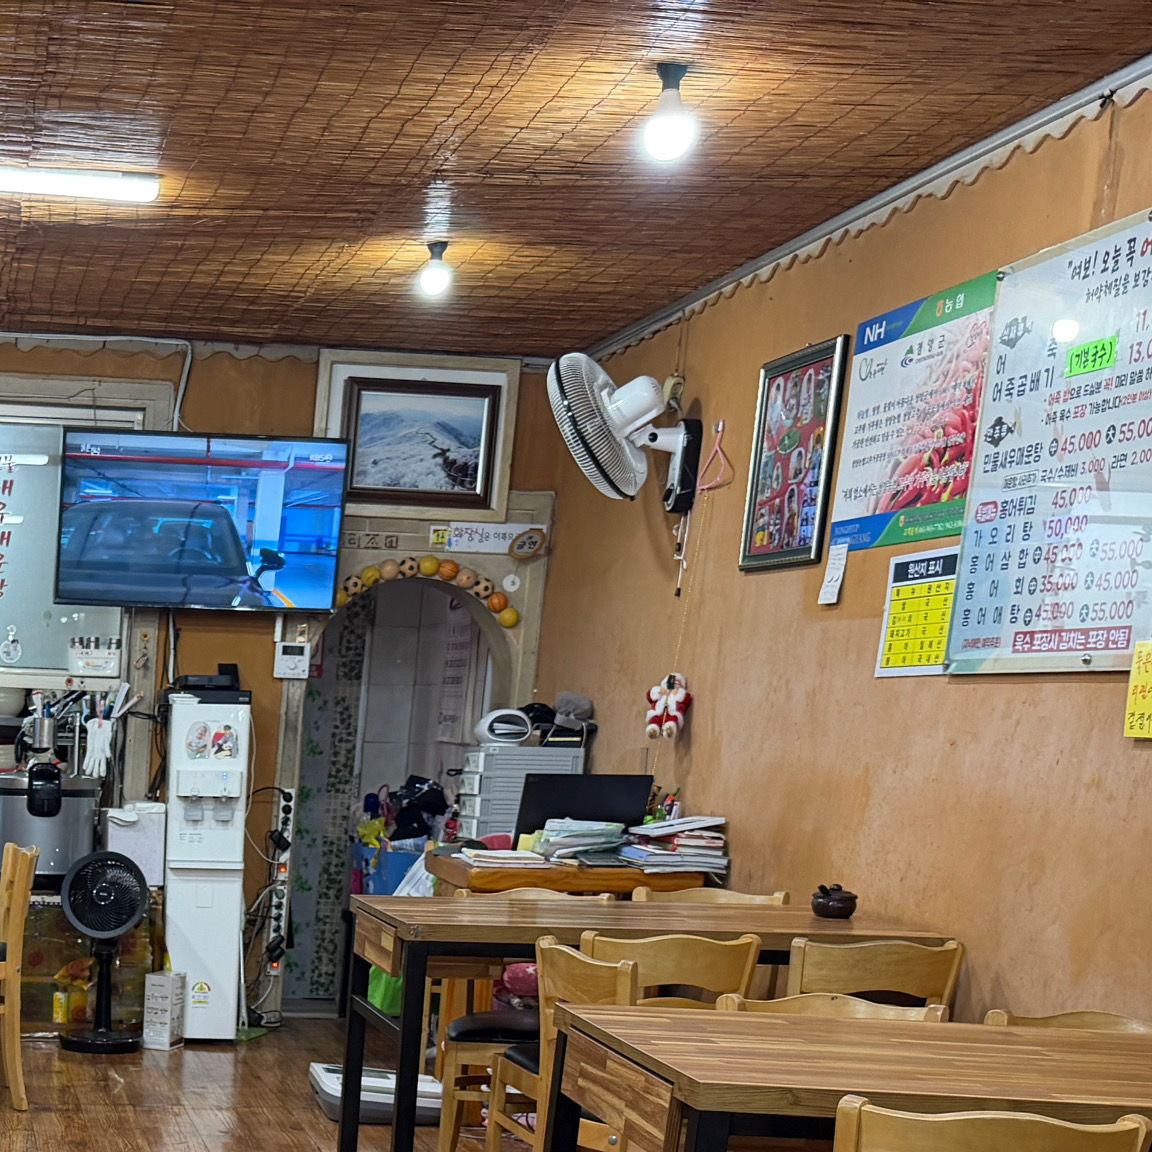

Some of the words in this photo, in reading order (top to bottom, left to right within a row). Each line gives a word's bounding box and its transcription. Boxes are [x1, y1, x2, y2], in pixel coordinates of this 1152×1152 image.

[1100, 245, 1121, 274] 오늘
[1126, 237, 1137, 267] 꼭
[1086, 273, 1130, 303] 허약체질을
[945, 293, 964, 312] 농협
[864, 321, 886, 345] NH
[992, 366, 1055, 402] 어죽곱배기
[1115, 374, 1128, 388] 미리
[1073, 405, 1087, 419] 포장
[983, 443, 1043, 473] 민물새우매운탕
[1060, 430, 1102, 455] 45,000
[1040, 463, 1079, 483] 국수/수제비
[1111, 453, 1128, 469] 라면
[999, 495, 1037, 519] 홍어튀김
[1051, 485, 1092, 509] 45,000
[453, 527, 491, 544] 화장실은
[1046, 515, 1088, 539] 50,000
[1100, 538, 1143, 561] 55,000
[908, 562, 927, 578] 원산지
[928, 559, 943, 574] 표시
[1039, 572, 1078, 592] 35,000
[1095, 569, 1138, 591] 45,000
[1090, 600, 1134, 622] 55,000
[1014, 635, 1031, 651] 육수
[1032, 633, 1058, 650] 포장시
[1059, 631, 1085, 649] 김치는
[1087, 630, 1108, 648] 포장
[1109, 628, 1129, 648] 안됨
